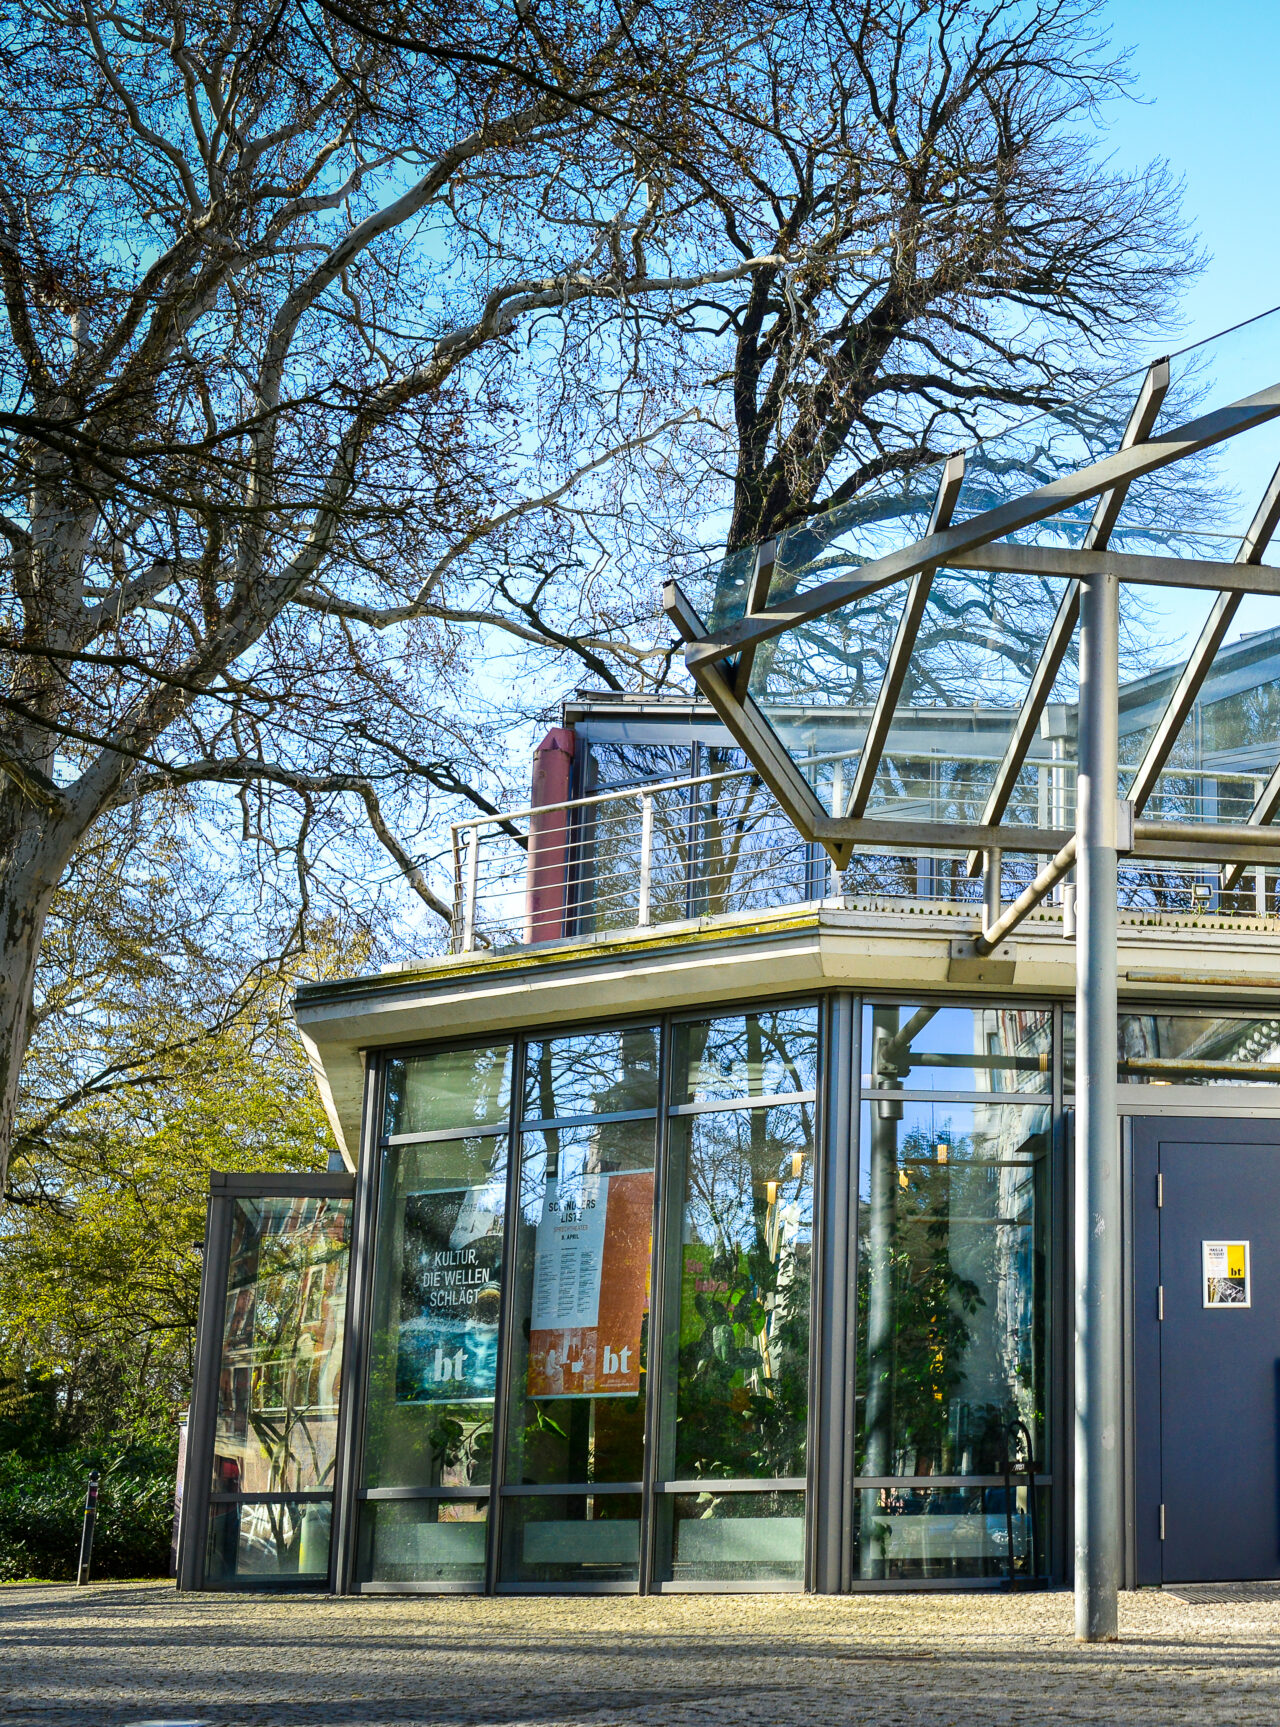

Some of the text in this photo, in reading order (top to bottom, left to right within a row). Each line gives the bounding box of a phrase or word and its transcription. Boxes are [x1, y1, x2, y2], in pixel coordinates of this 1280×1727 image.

[434, 1249, 479, 1267] KULTUR,
[423, 1268, 490, 1287] DIE WELLEN
[1231, 1268, 1242, 1276] bt
[430, 1287, 480, 1307] SCHLÄGT
[433, 1347, 469, 1382] bt
[603, 1345, 632, 1375] bt
